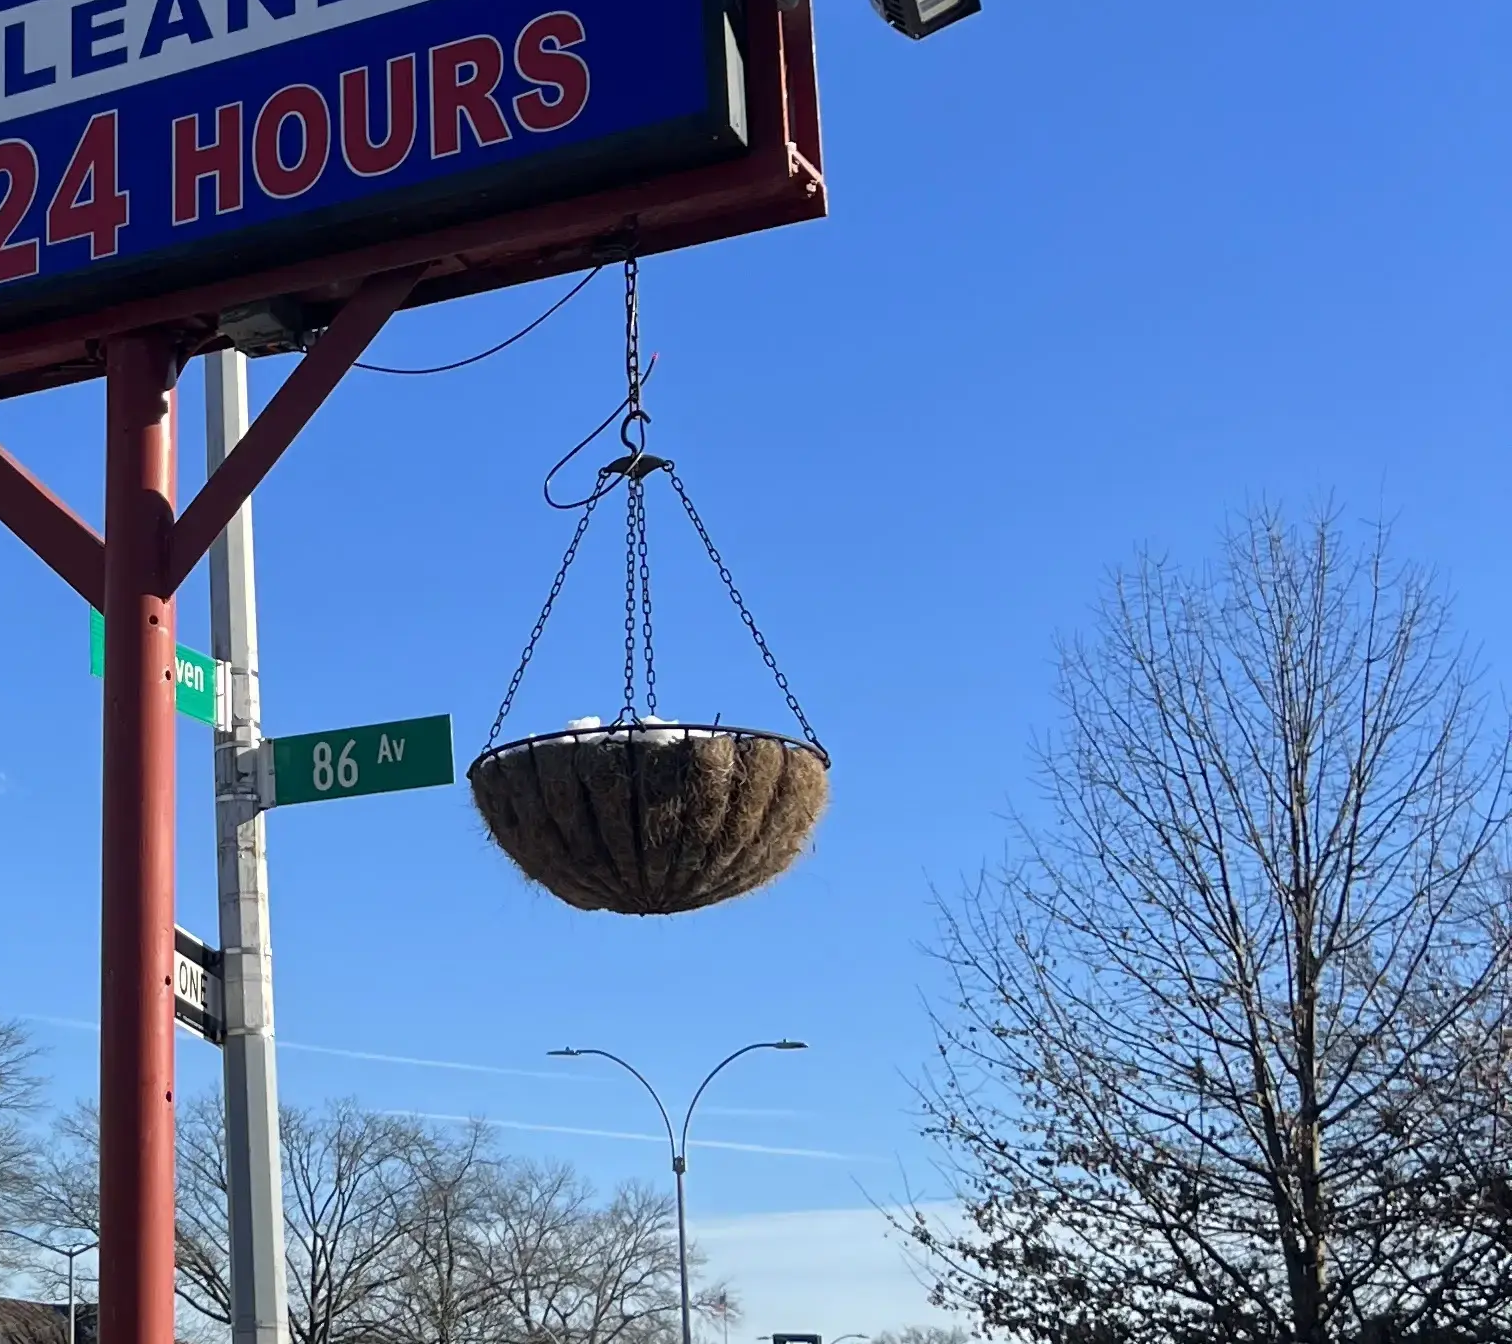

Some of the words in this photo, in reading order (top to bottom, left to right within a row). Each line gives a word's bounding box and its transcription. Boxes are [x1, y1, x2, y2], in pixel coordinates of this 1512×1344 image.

[172, 10, 590, 225] HOURS
[312, 738, 359, 791] 86
[377, 733, 406, 764] Av
[179, 960, 208, 1009] ONE
